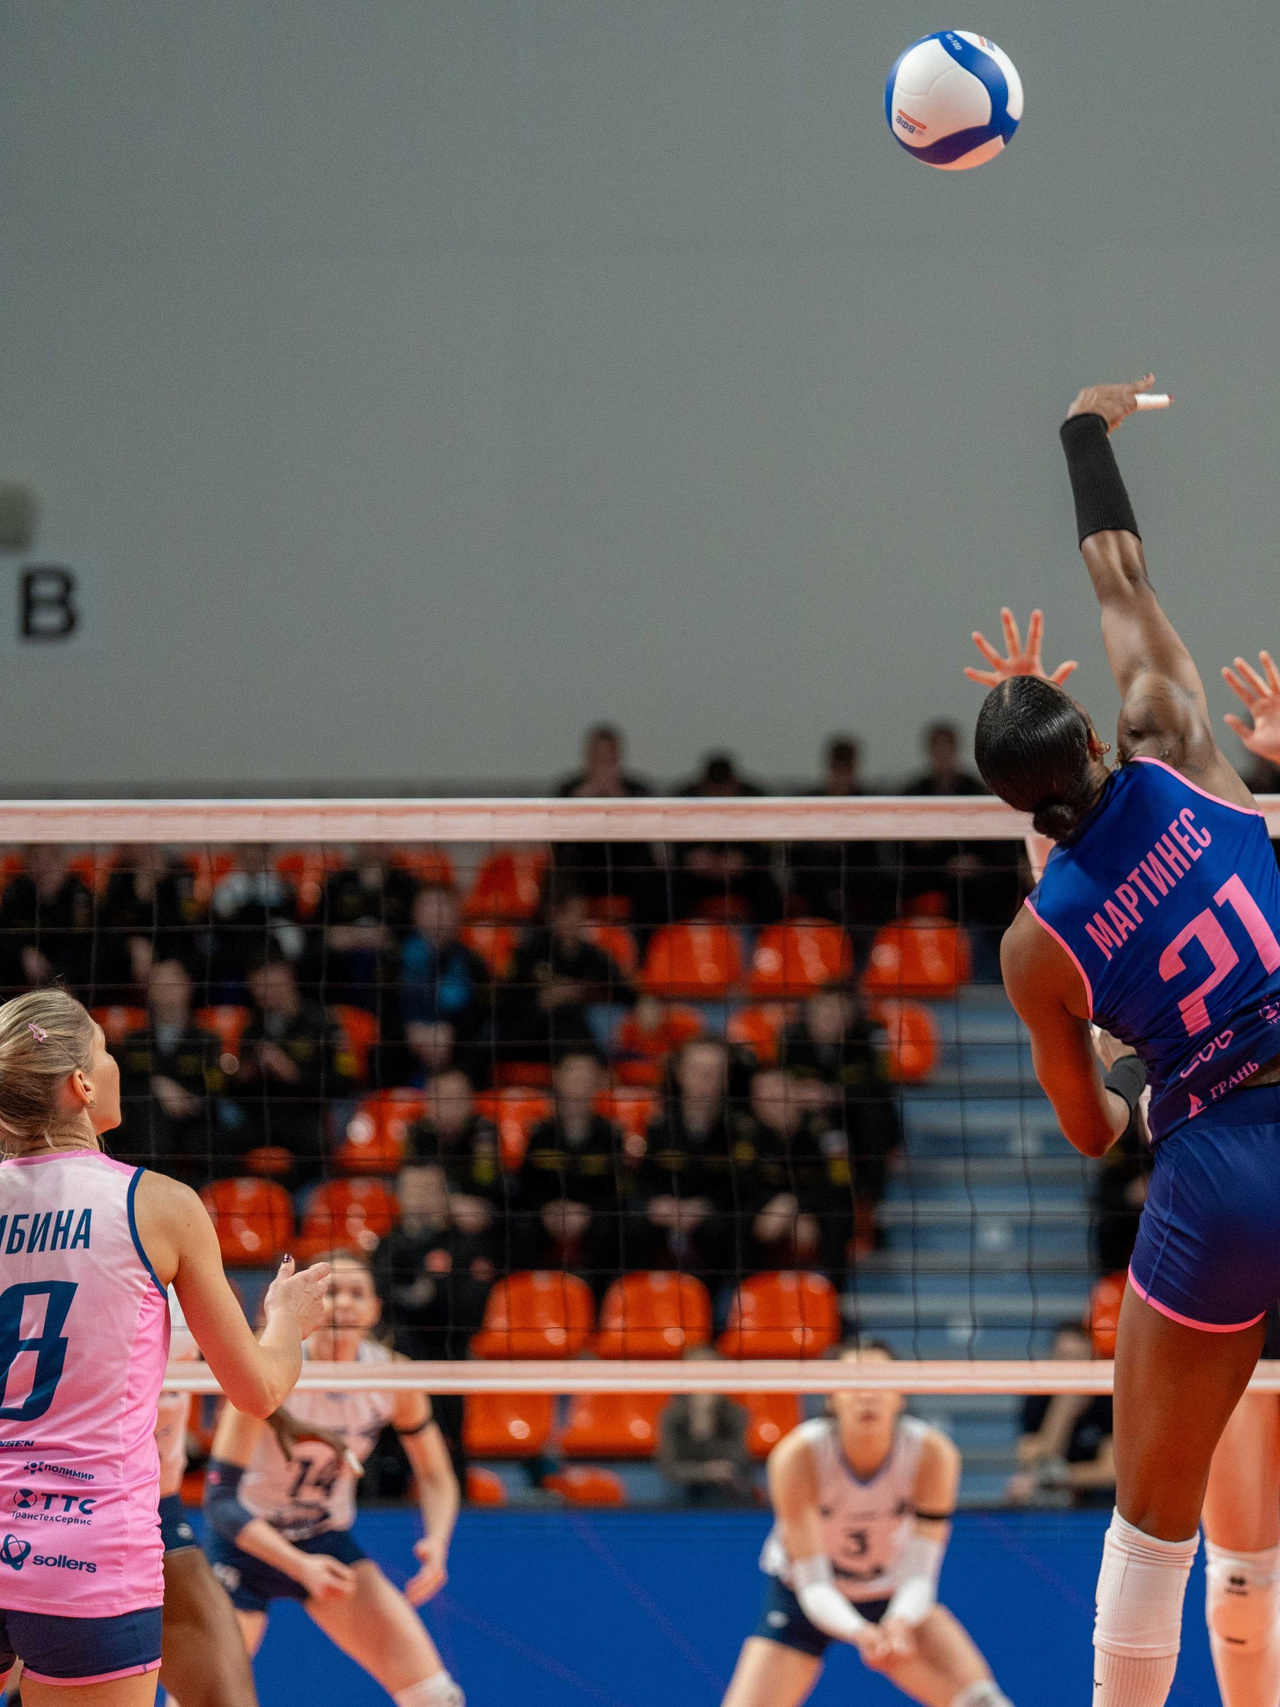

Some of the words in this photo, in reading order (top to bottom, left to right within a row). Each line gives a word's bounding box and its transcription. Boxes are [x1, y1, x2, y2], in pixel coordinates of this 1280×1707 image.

[1085, 807, 1212, 961] МАРТИНЕС
[1209, 1060, 1260, 1101] ГРАНЬ
[0, 1280, 79, 1422] 8
[44, 1463, 95, 1481] ПОЛИМИР
[11, 1510, 93, 1526] ТрансТехСервис
[32, 1554, 98, 1574] sollers
